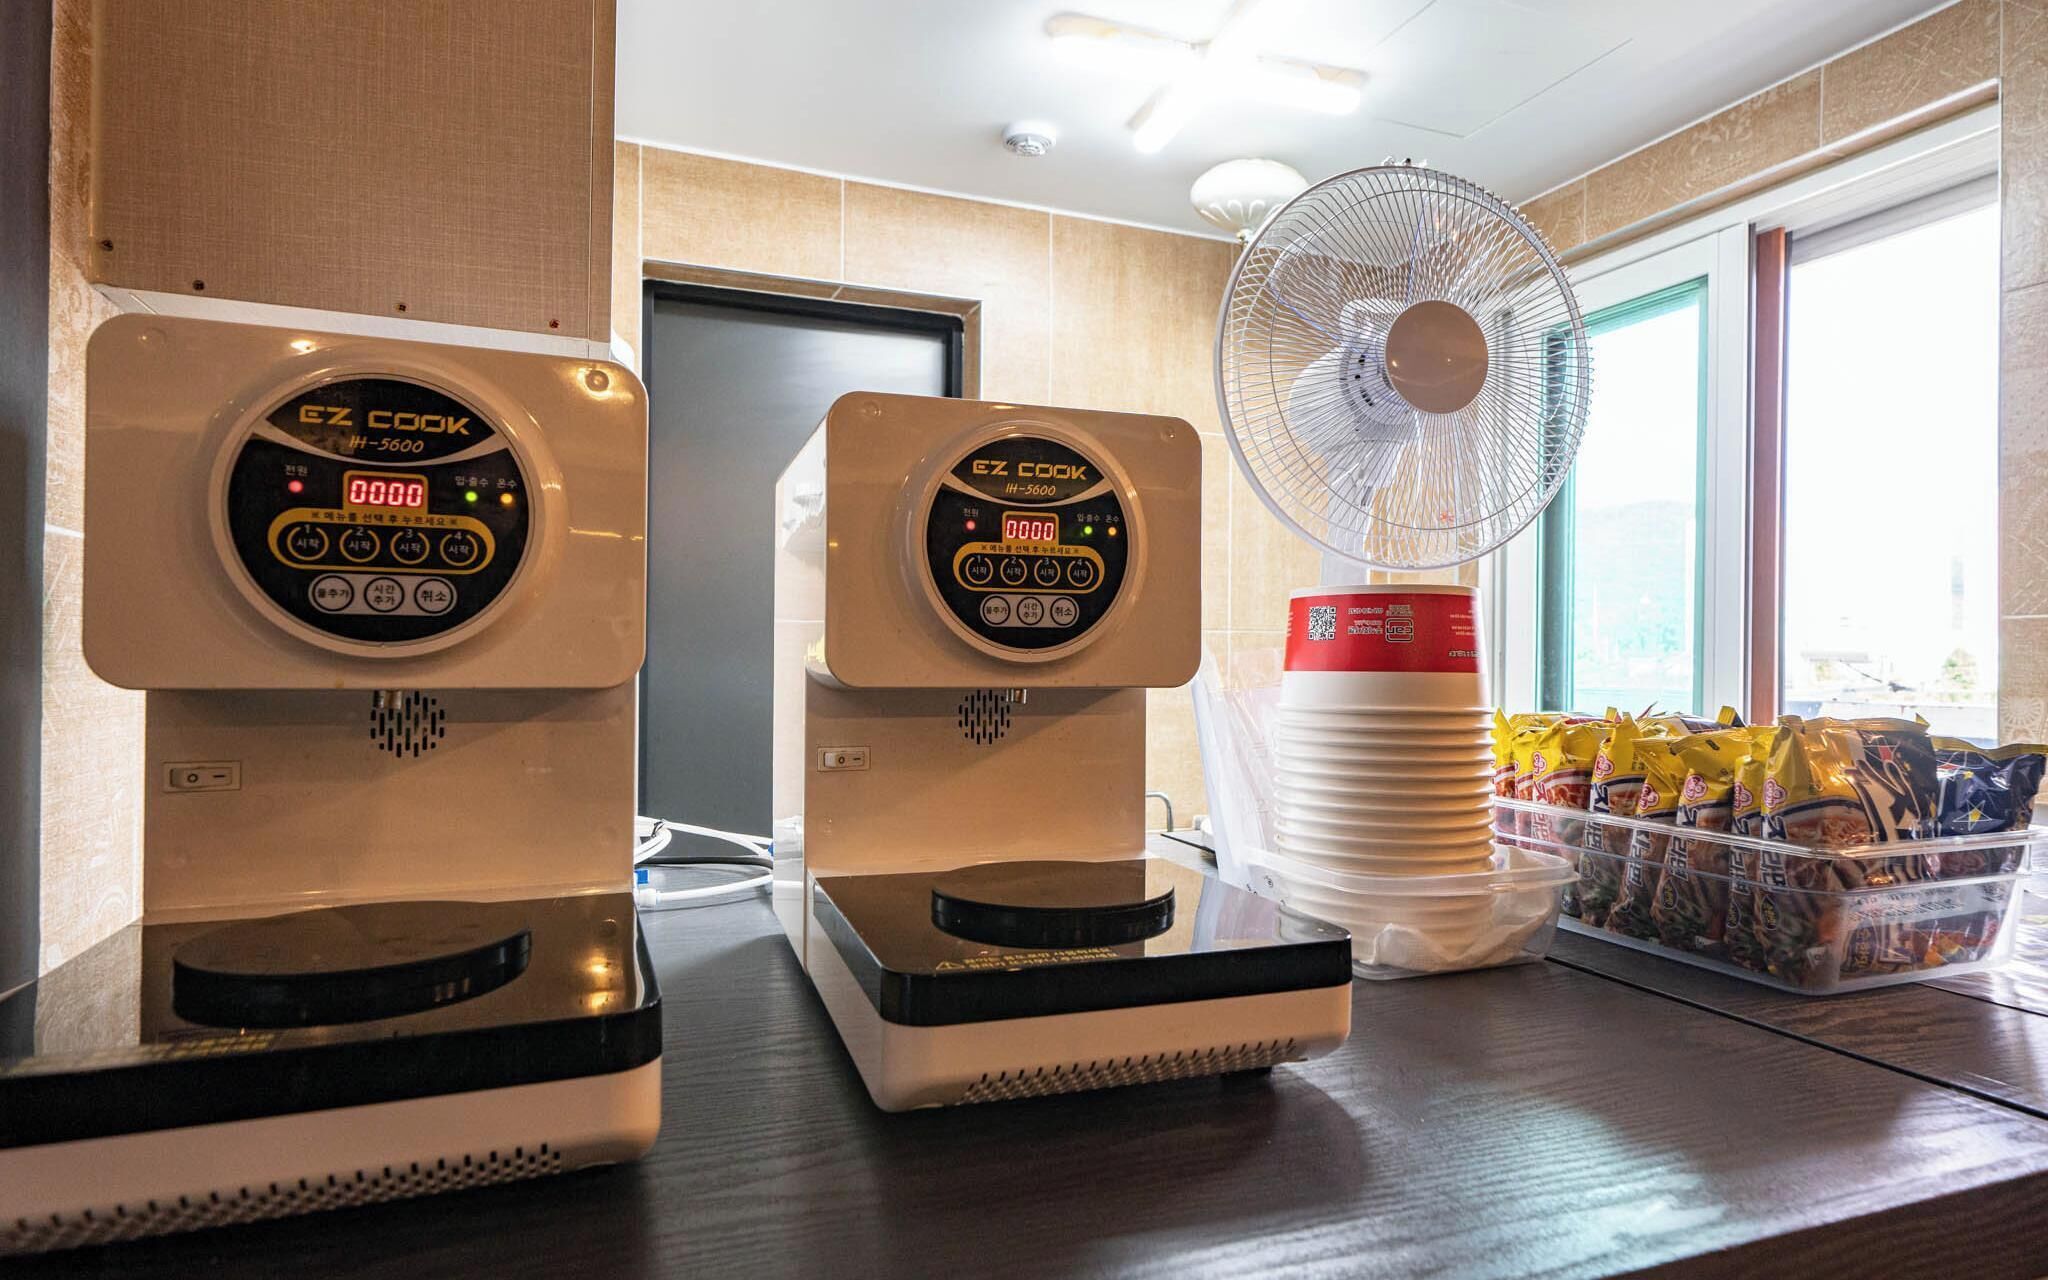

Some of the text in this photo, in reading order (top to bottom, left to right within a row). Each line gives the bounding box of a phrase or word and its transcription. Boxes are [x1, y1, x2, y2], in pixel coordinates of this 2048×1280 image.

[300, 405, 469, 436] EZ COOK
[349, 436, 423, 453] IH-5600
[285, 465, 308, 476] 전원
[972, 460, 1087, 480] EZ COOK
[496, 478, 516, 489] 온수
[350, 480, 423, 506] 0000
[1006, 483, 1056, 496] IH-5600
[323, 512, 447, 526] 메뉴를 선택 후 누르세요
[305, 525, 311, 533] 1
[356, 527, 363, 536] 2
[406, 529, 413, 538] 3
[1006, 520, 1054, 541] 0000
[454, 532, 462, 540] 4
[297, 538, 320, 548] 시작
[349, 540, 371, 551] 시작
[399, 543, 421, 553] 시작
[448, 545, 469, 555] 시작
[972, 566, 987, 575] 시작
[1007, 568, 1022, 576] 시작
[1040, 568, 1054, 577] 시작
[1073, 569, 1087, 578] 시작
[317, 588, 349, 600] 물추가
[374, 585, 395, 594] 시간
[373, 595, 395, 605] 추가
[421, 589, 447, 603] 취소
[1055, 607, 1072, 617] 취소
